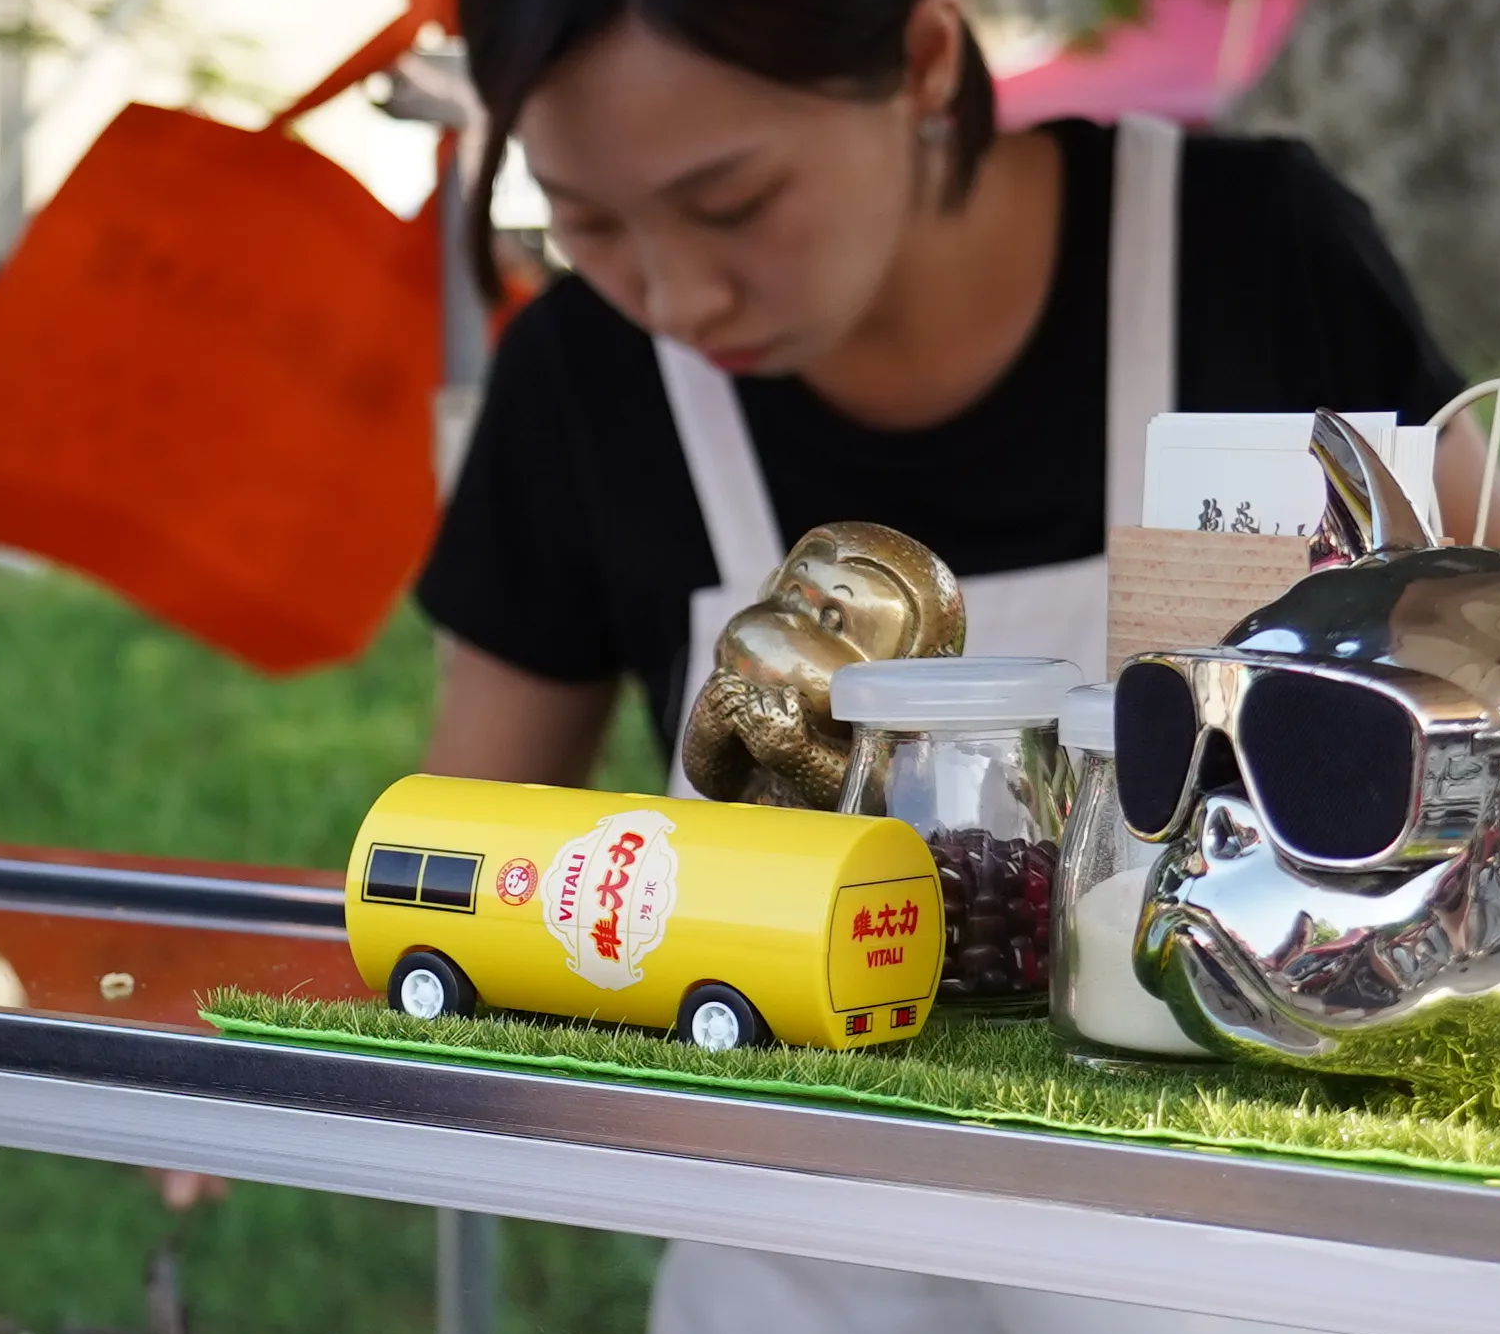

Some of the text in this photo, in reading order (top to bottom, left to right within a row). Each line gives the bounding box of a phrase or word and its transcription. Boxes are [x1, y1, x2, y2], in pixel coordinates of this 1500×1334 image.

[559, 854, 586, 921] VITALI
[590, 831, 644, 961] 維大力
[852, 899, 919, 942] 維大力
[866, 947, 903, 968] VITALI
